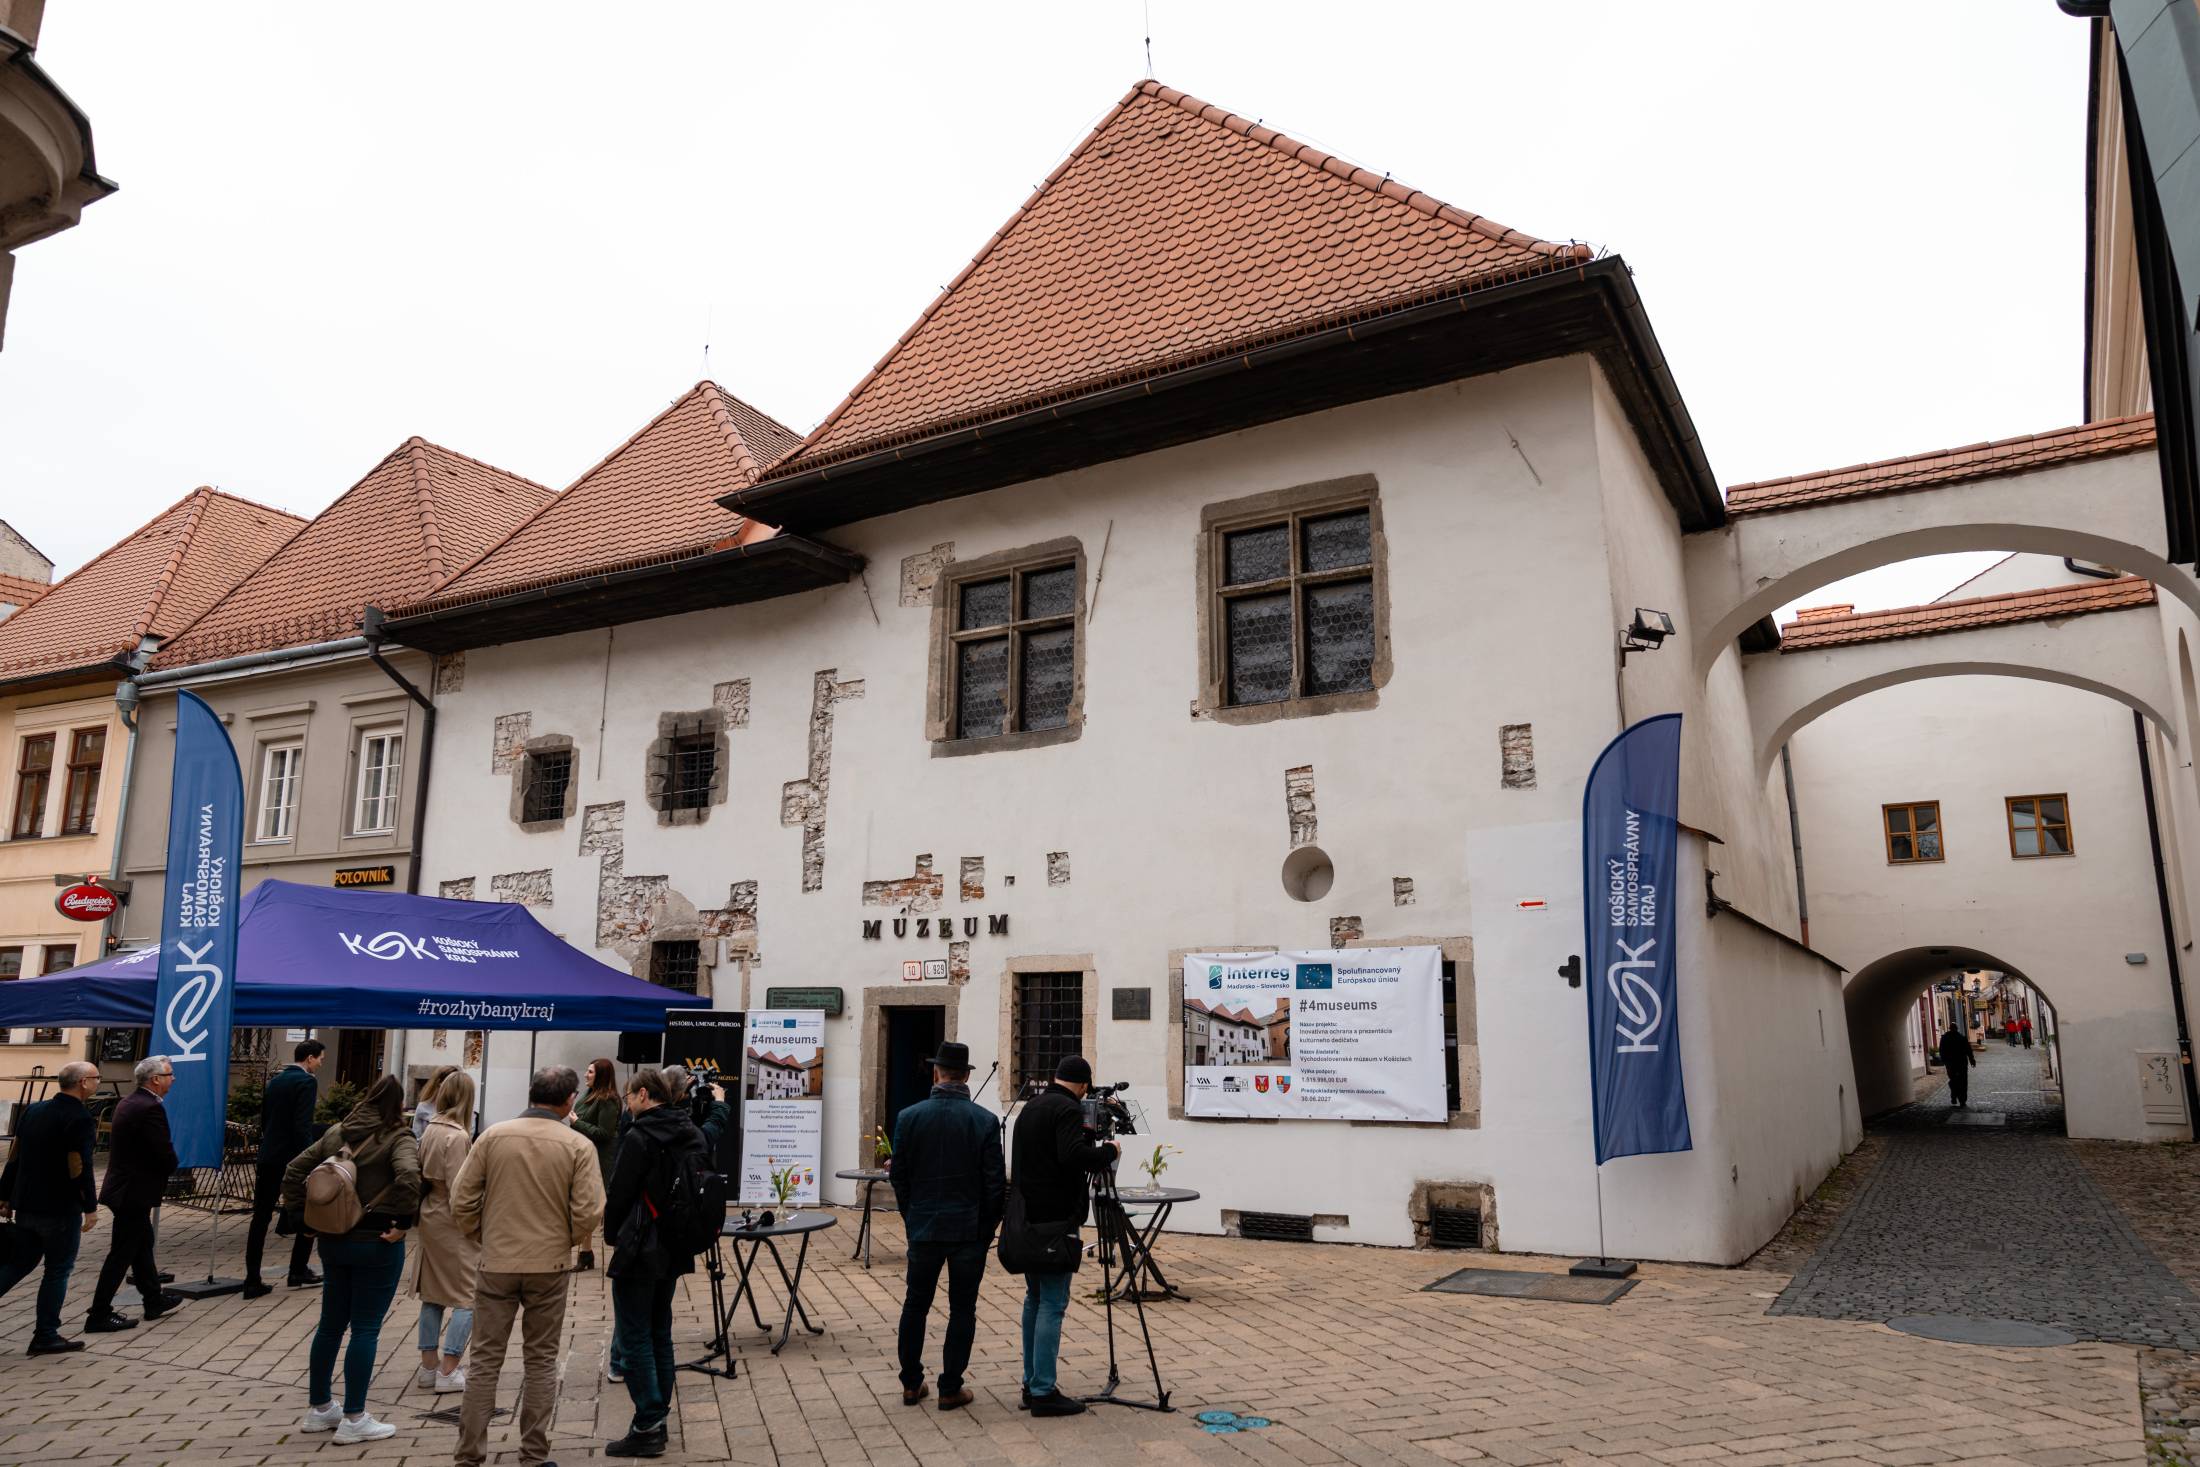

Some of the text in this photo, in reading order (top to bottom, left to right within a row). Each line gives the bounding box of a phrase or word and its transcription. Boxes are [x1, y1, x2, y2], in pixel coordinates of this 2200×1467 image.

[1622, 809, 1640, 927] SAMOSPRÁVNY
[1607, 858, 1625, 927] KOŠICKÝ
[1640, 884, 1656, 927] KRAJ
[862, 907, 1009, 939] MÚZEUM
[431, 936, 479, 950] KOŠICKÝ
[438, 945, 520, 959] SAMOSPRÁVNY
[444, 953, 477, 964] KRAJ
[1227, 967, 1290, 981] Interreg
[1337, 966, 1402, 975] Spolufinancovaný
[1337, 976, 1376, 985] Európskou
[417, 998, 555, 1022] #rozhybanykraj
[1299, 999, 1378, 1012] #4museums
[751, 1033, 818, 1045] #4museums
